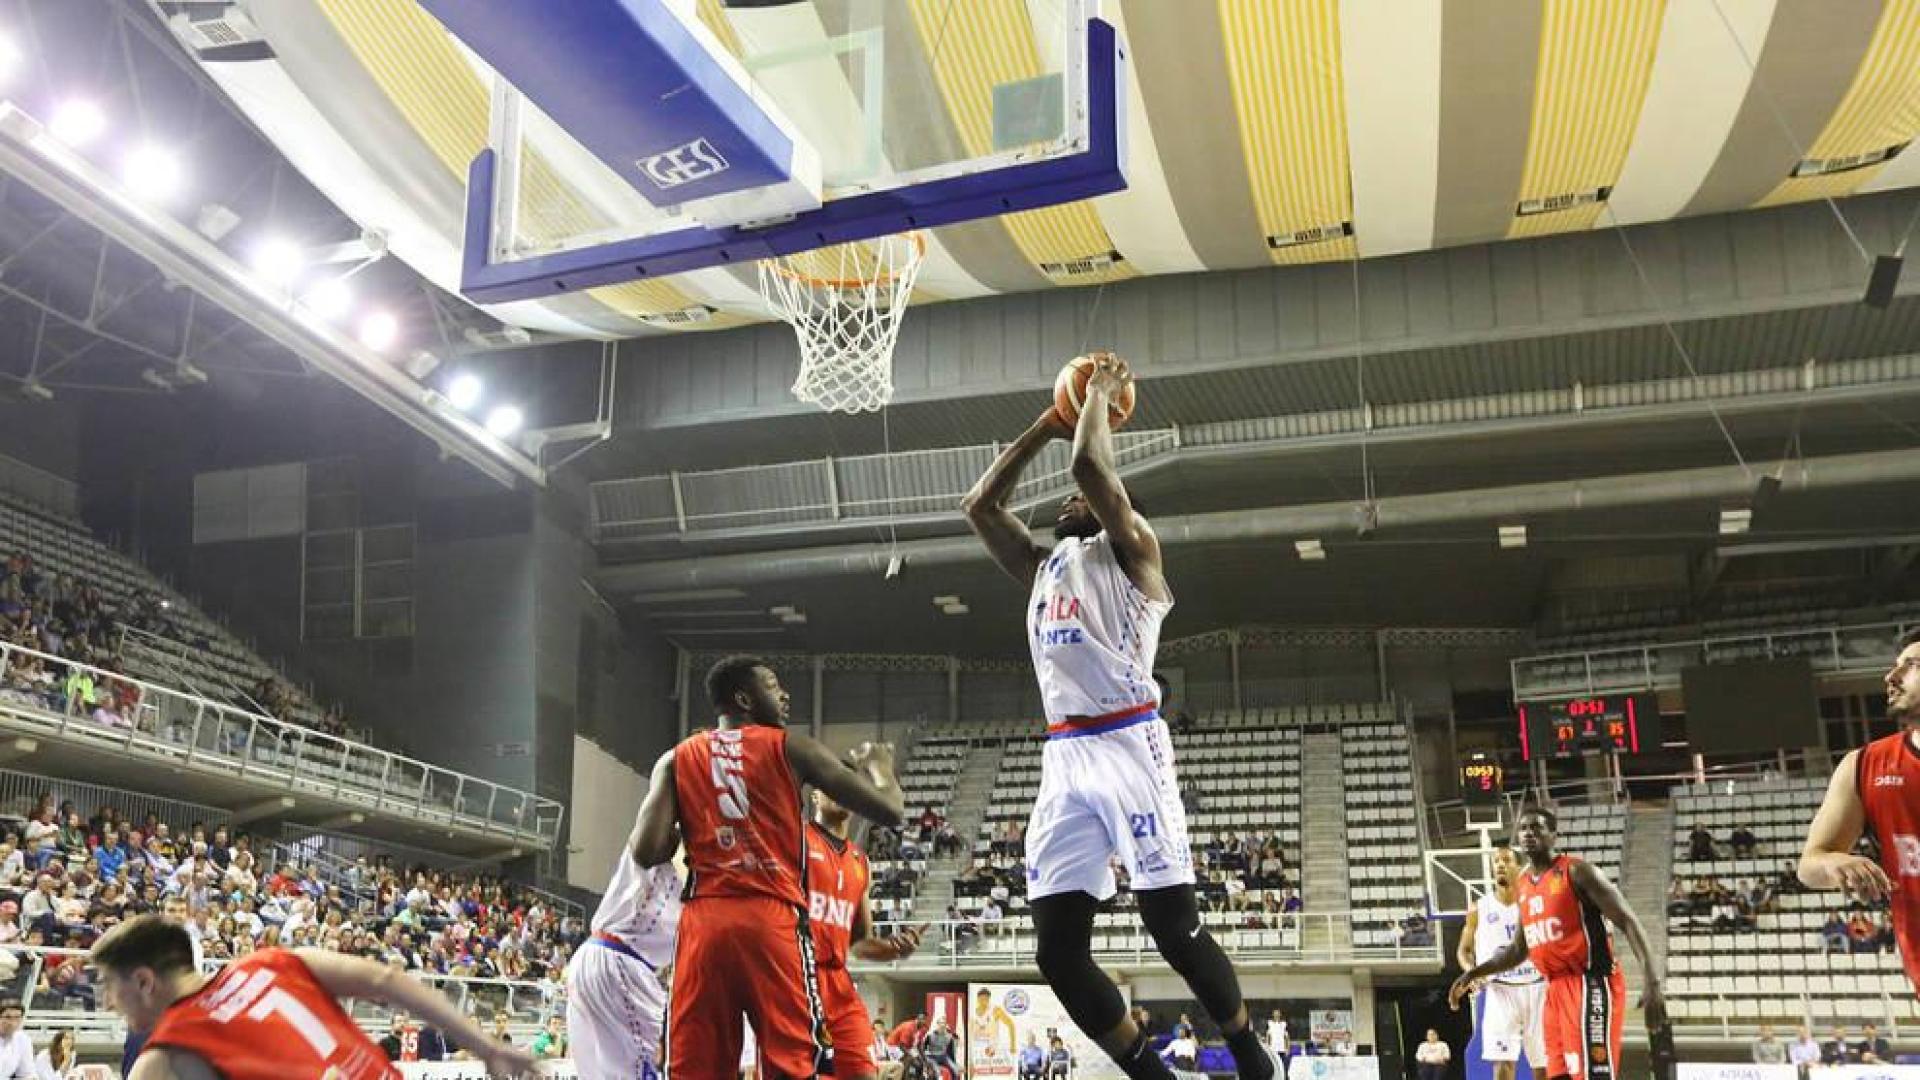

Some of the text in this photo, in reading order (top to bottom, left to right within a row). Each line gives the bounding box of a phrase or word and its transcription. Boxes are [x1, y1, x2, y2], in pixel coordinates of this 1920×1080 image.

[645, 141, 722, 184] GES
[711, 757, 750, 819] 5
[1132, 812, 1157, 838] 21
[247, 985, 339, 1060] 7
